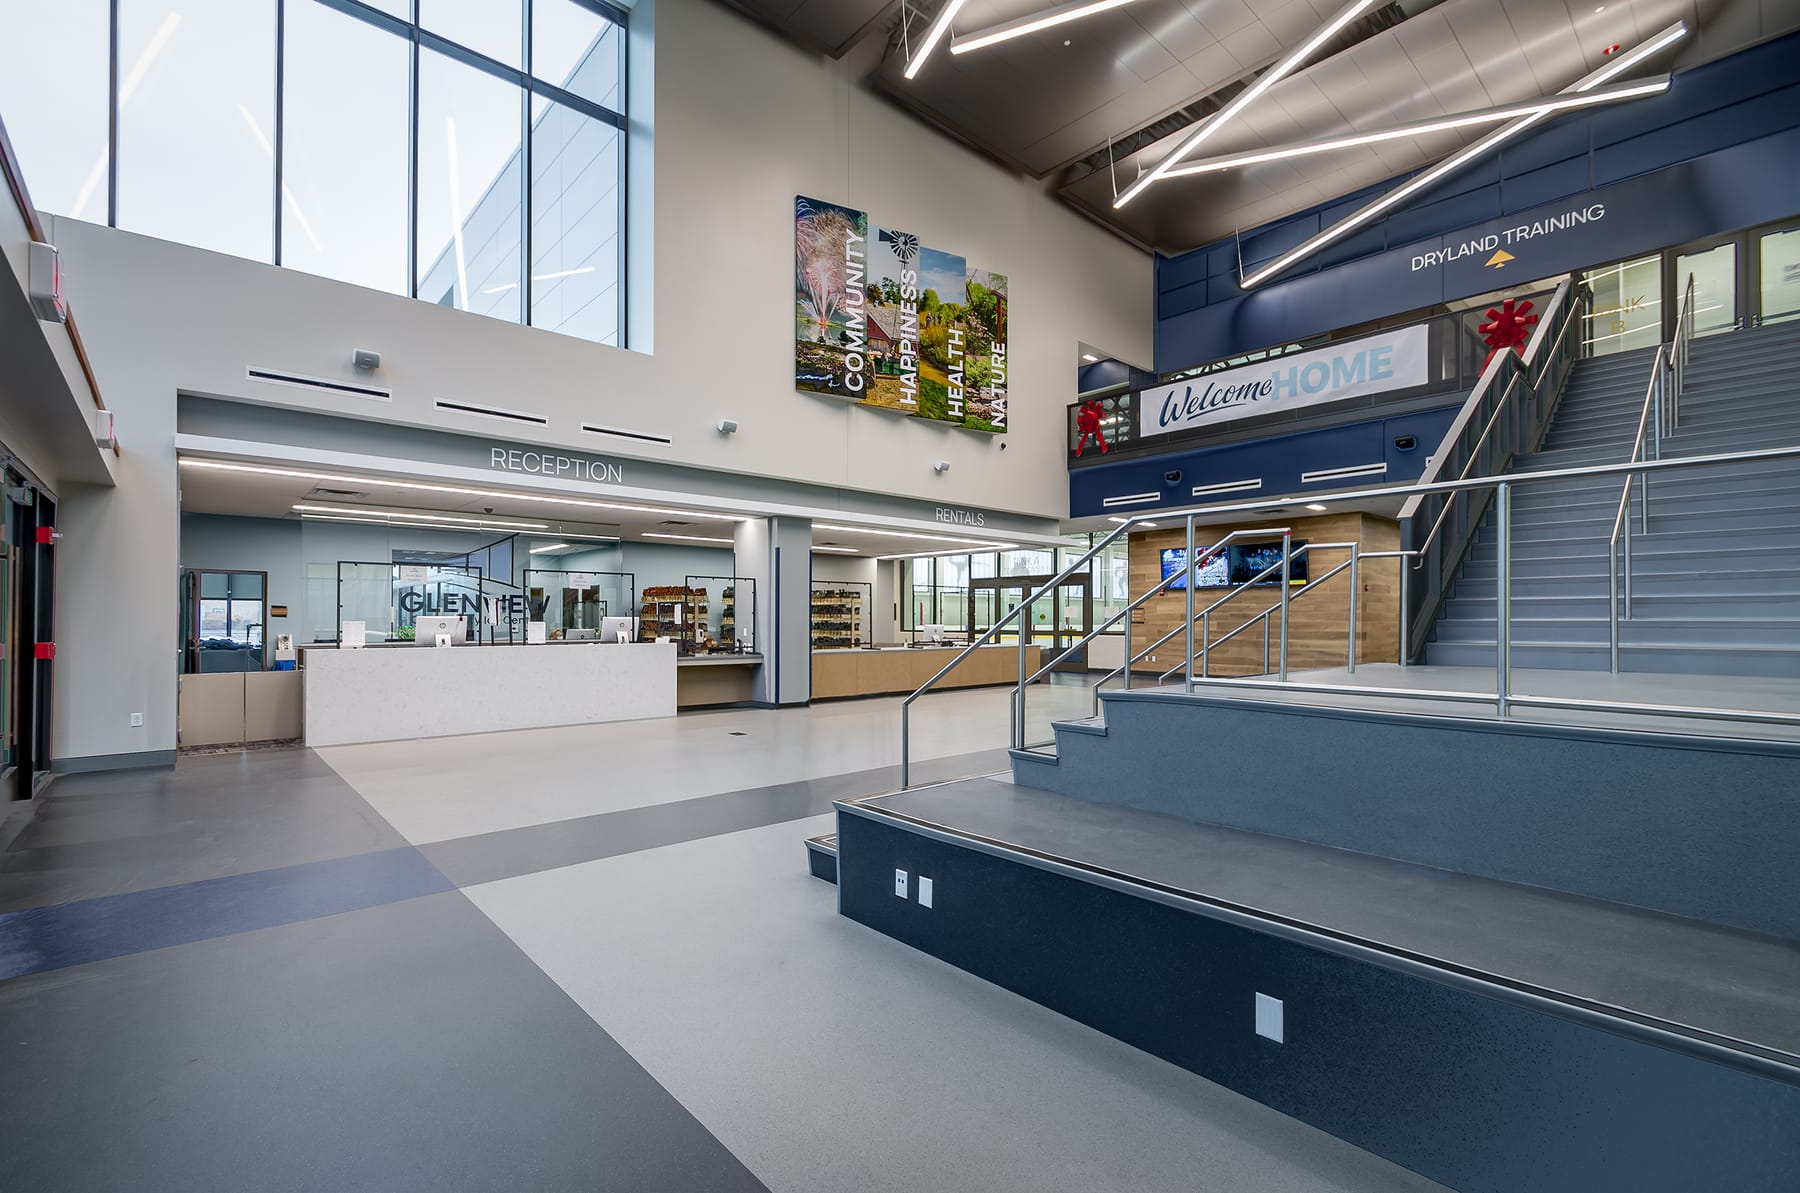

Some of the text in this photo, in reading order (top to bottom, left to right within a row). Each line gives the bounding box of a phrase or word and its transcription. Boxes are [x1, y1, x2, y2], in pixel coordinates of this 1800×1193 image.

[1411, 203, 1606, 272] DRYLAND TRAINING
[845, 228, 865, 392] COMMUNITY
[899, 270, 918, 405] HAPPINESS
[947, 328, 964, 417] HEALTH
[990, 341, 1006, 427] NATURE
[1159, 345, 1396, 428] Welcome HOME
[491, 447, 623, 483] RECEPTION
[935, 507, 985, 527] RENTALS
